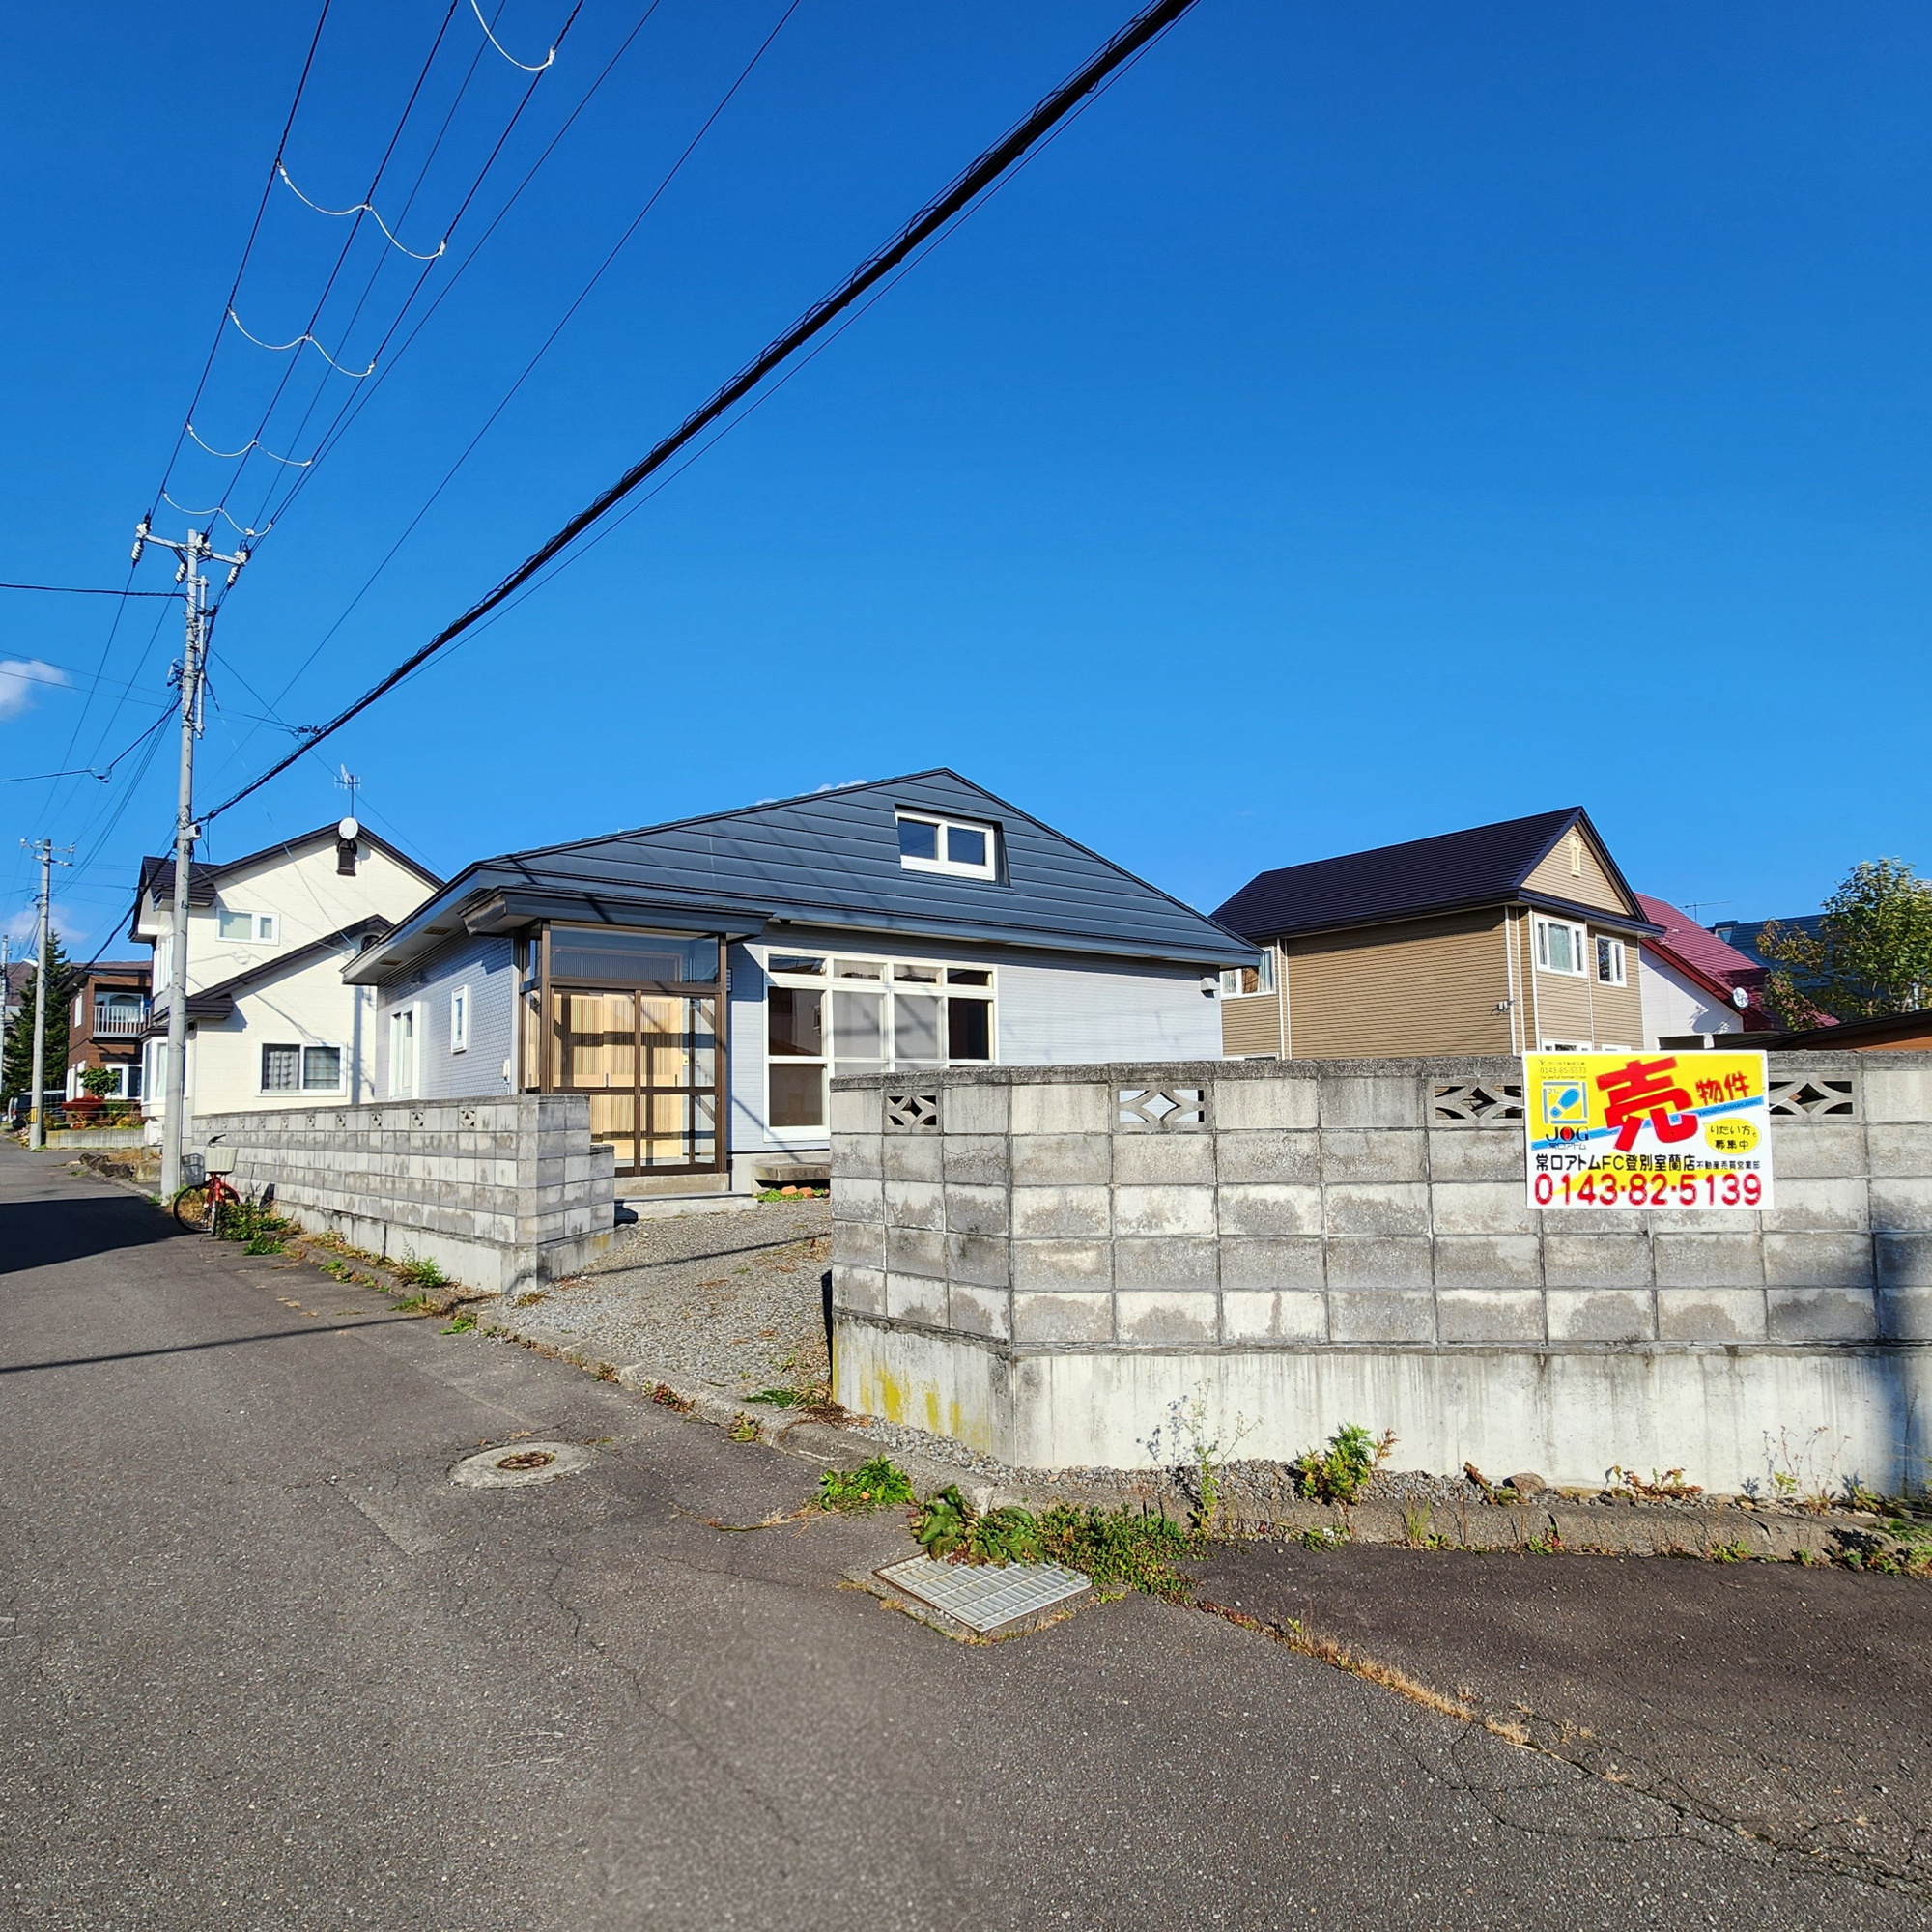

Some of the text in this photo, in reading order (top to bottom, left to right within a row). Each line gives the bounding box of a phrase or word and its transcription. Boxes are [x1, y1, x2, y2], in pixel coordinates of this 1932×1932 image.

[1695, 1070, 1750, 1106] 物件
[1595, 1056, 1698, 1152] 売
[1546, 1126, 1589, 1141] JOG
[1715, 1139, 1749, 1150] 募集中
